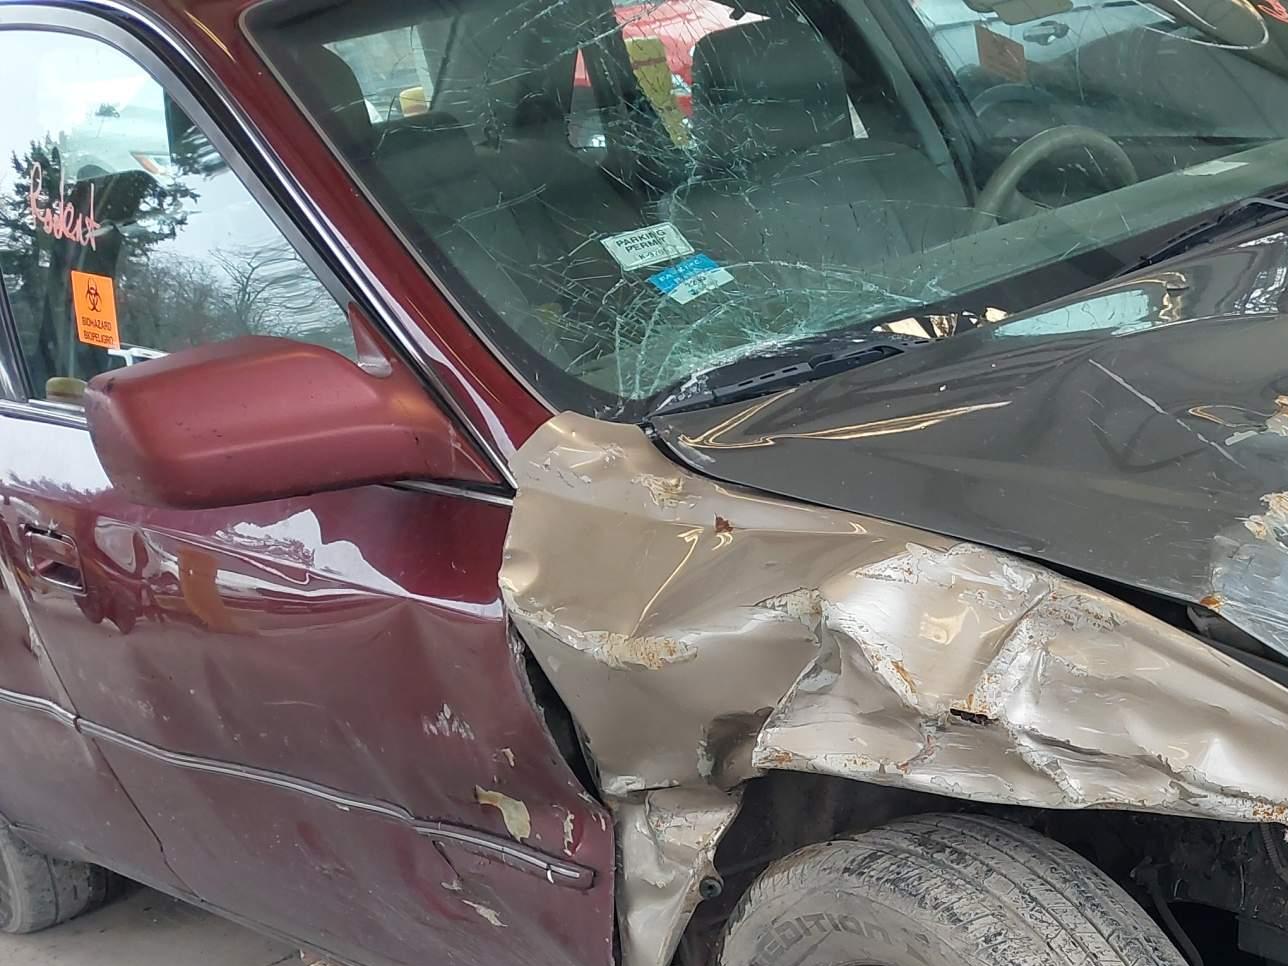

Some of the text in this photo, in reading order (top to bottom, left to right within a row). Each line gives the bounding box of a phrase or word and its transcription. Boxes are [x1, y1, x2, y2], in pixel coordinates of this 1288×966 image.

[615, 229, 667, 247] PARKING
[624, 237, 667, 253] PERMIT
[81, 315, 112, 332] BIOHAZARD
